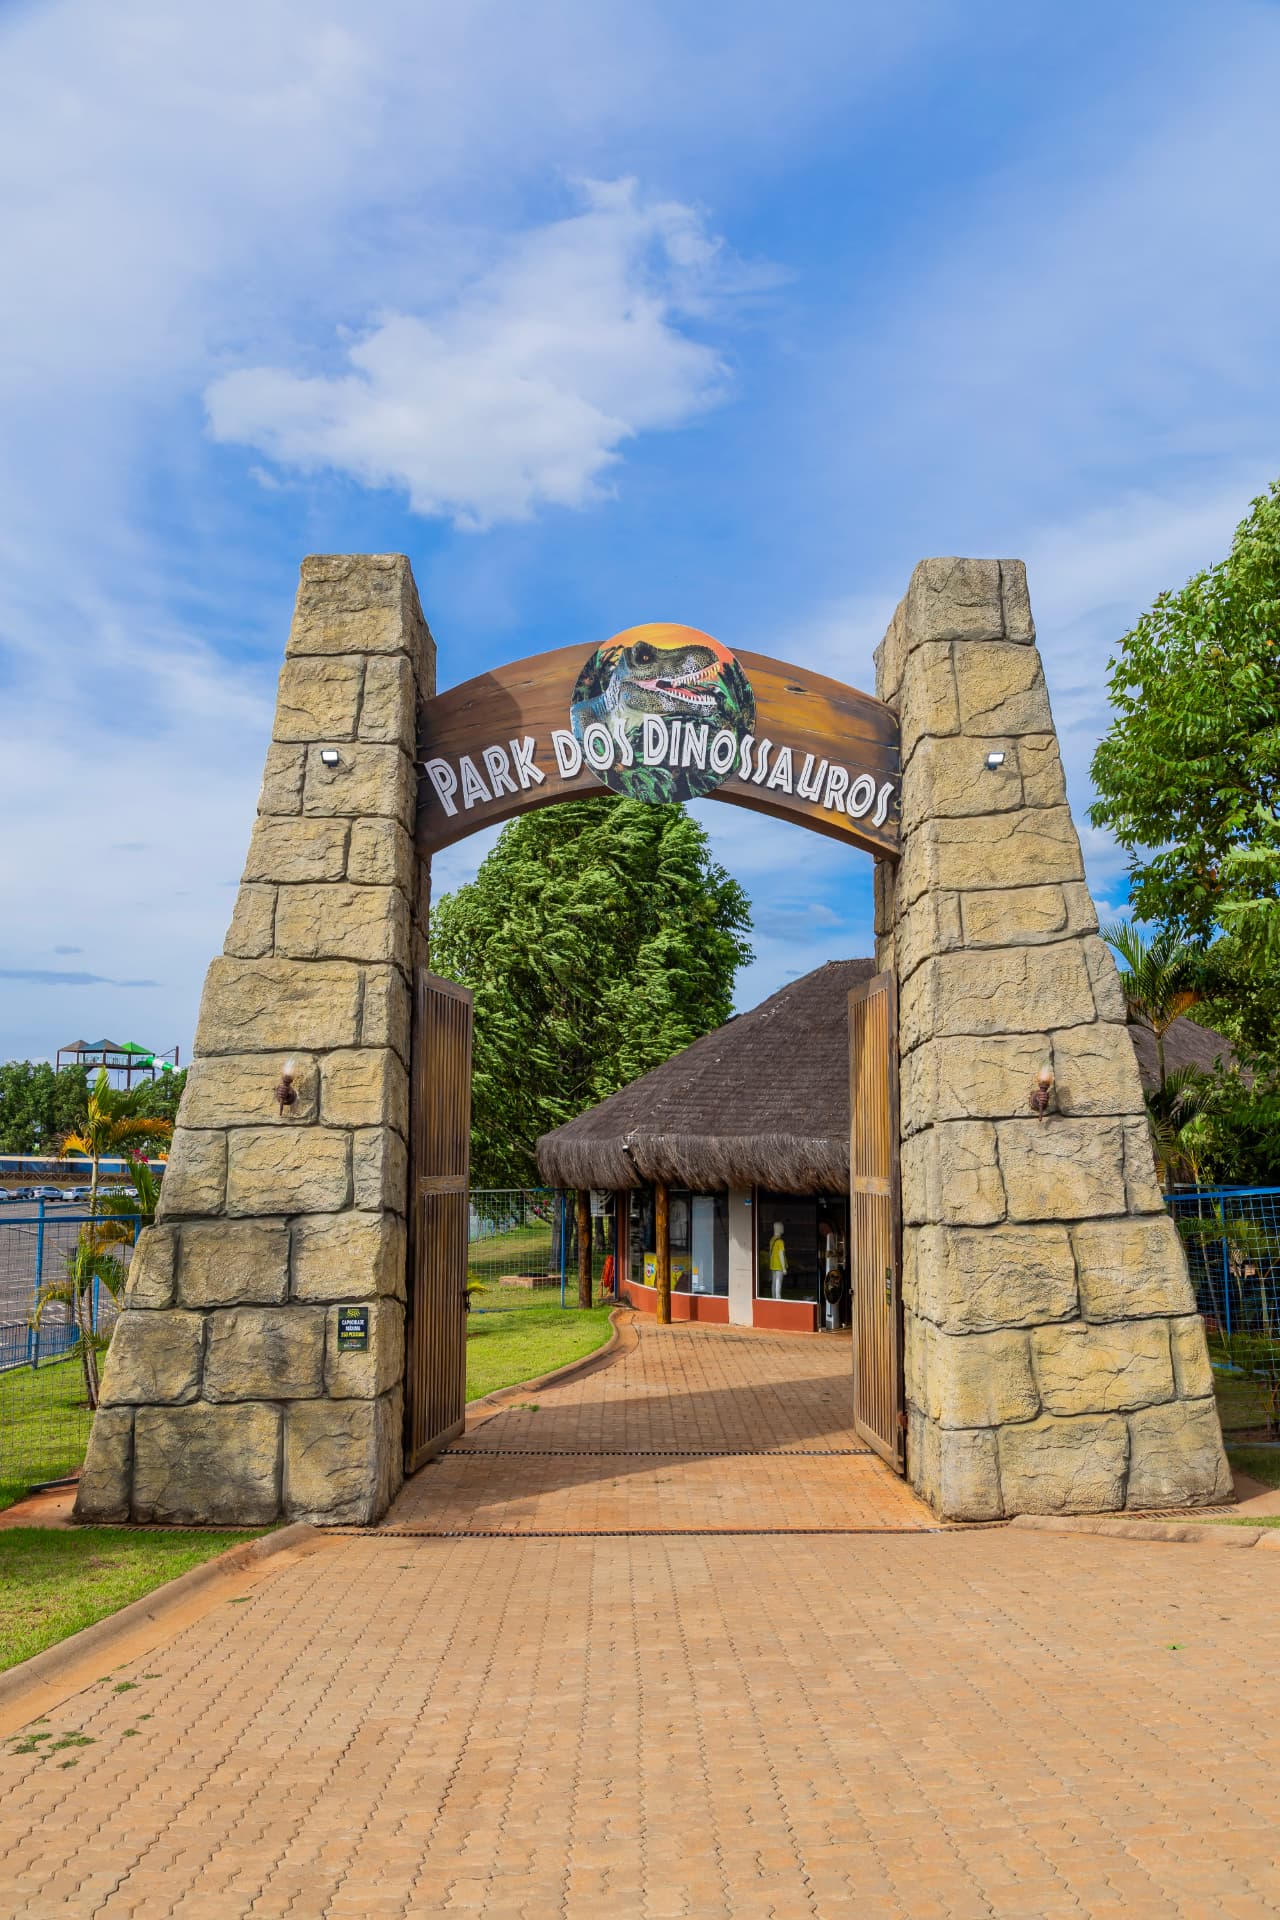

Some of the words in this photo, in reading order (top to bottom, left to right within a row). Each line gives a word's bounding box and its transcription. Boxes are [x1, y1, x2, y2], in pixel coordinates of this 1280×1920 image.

[424, 735, 546, 817] PARK
[551, 717, 634, 779] DOS
[643, 713, 895, 828] DINOSSAUROS
